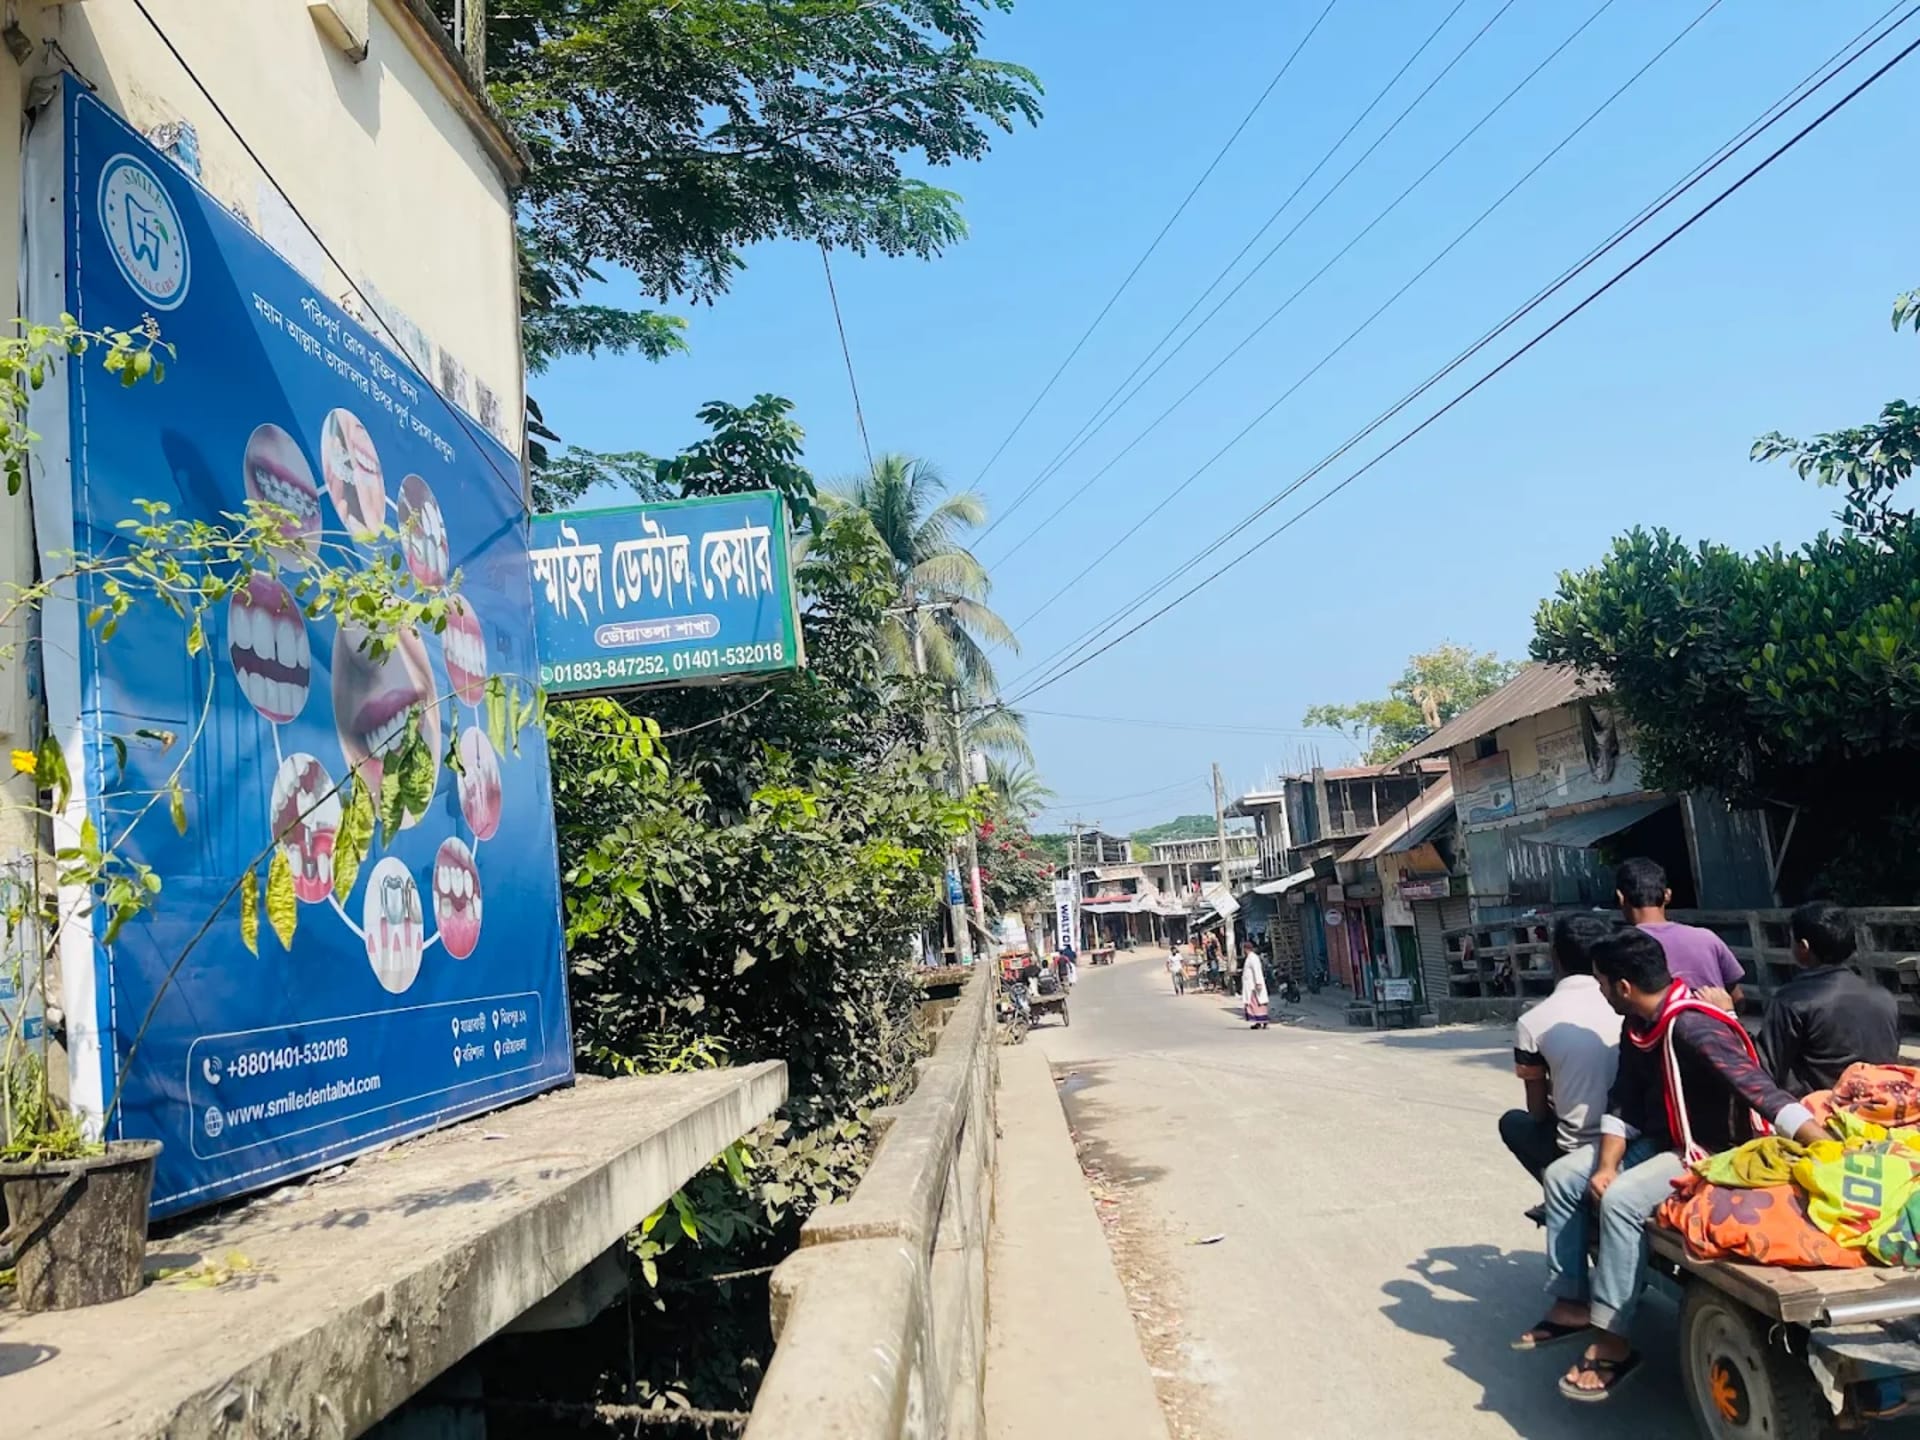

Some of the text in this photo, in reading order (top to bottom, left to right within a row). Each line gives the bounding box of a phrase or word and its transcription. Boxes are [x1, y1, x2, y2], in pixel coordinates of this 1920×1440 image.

[122, 167, 162, 208] SMILE
[252, 291, 283, 331] মহান
[285, 317, 322, 361] আল্লাহ
[370, 377, 393, 413] উপর
[300, 297, 340, 344] পরিপূর্ণ
[343, 331, 366, 362] রোগ
[398, 376, 418, 405] জন্য
[528, 511, 774, 626] স্মাইল ডেন্টাল কেয়ার
[676, 619, 711, 636] শাখা
[554, 643, 783, 684] 01833-847252, 01401-532018
[226, 1037, 349, 1079] +8801401-532018
[226, 1073, 381, 1128] www.smiledentalbd.com
